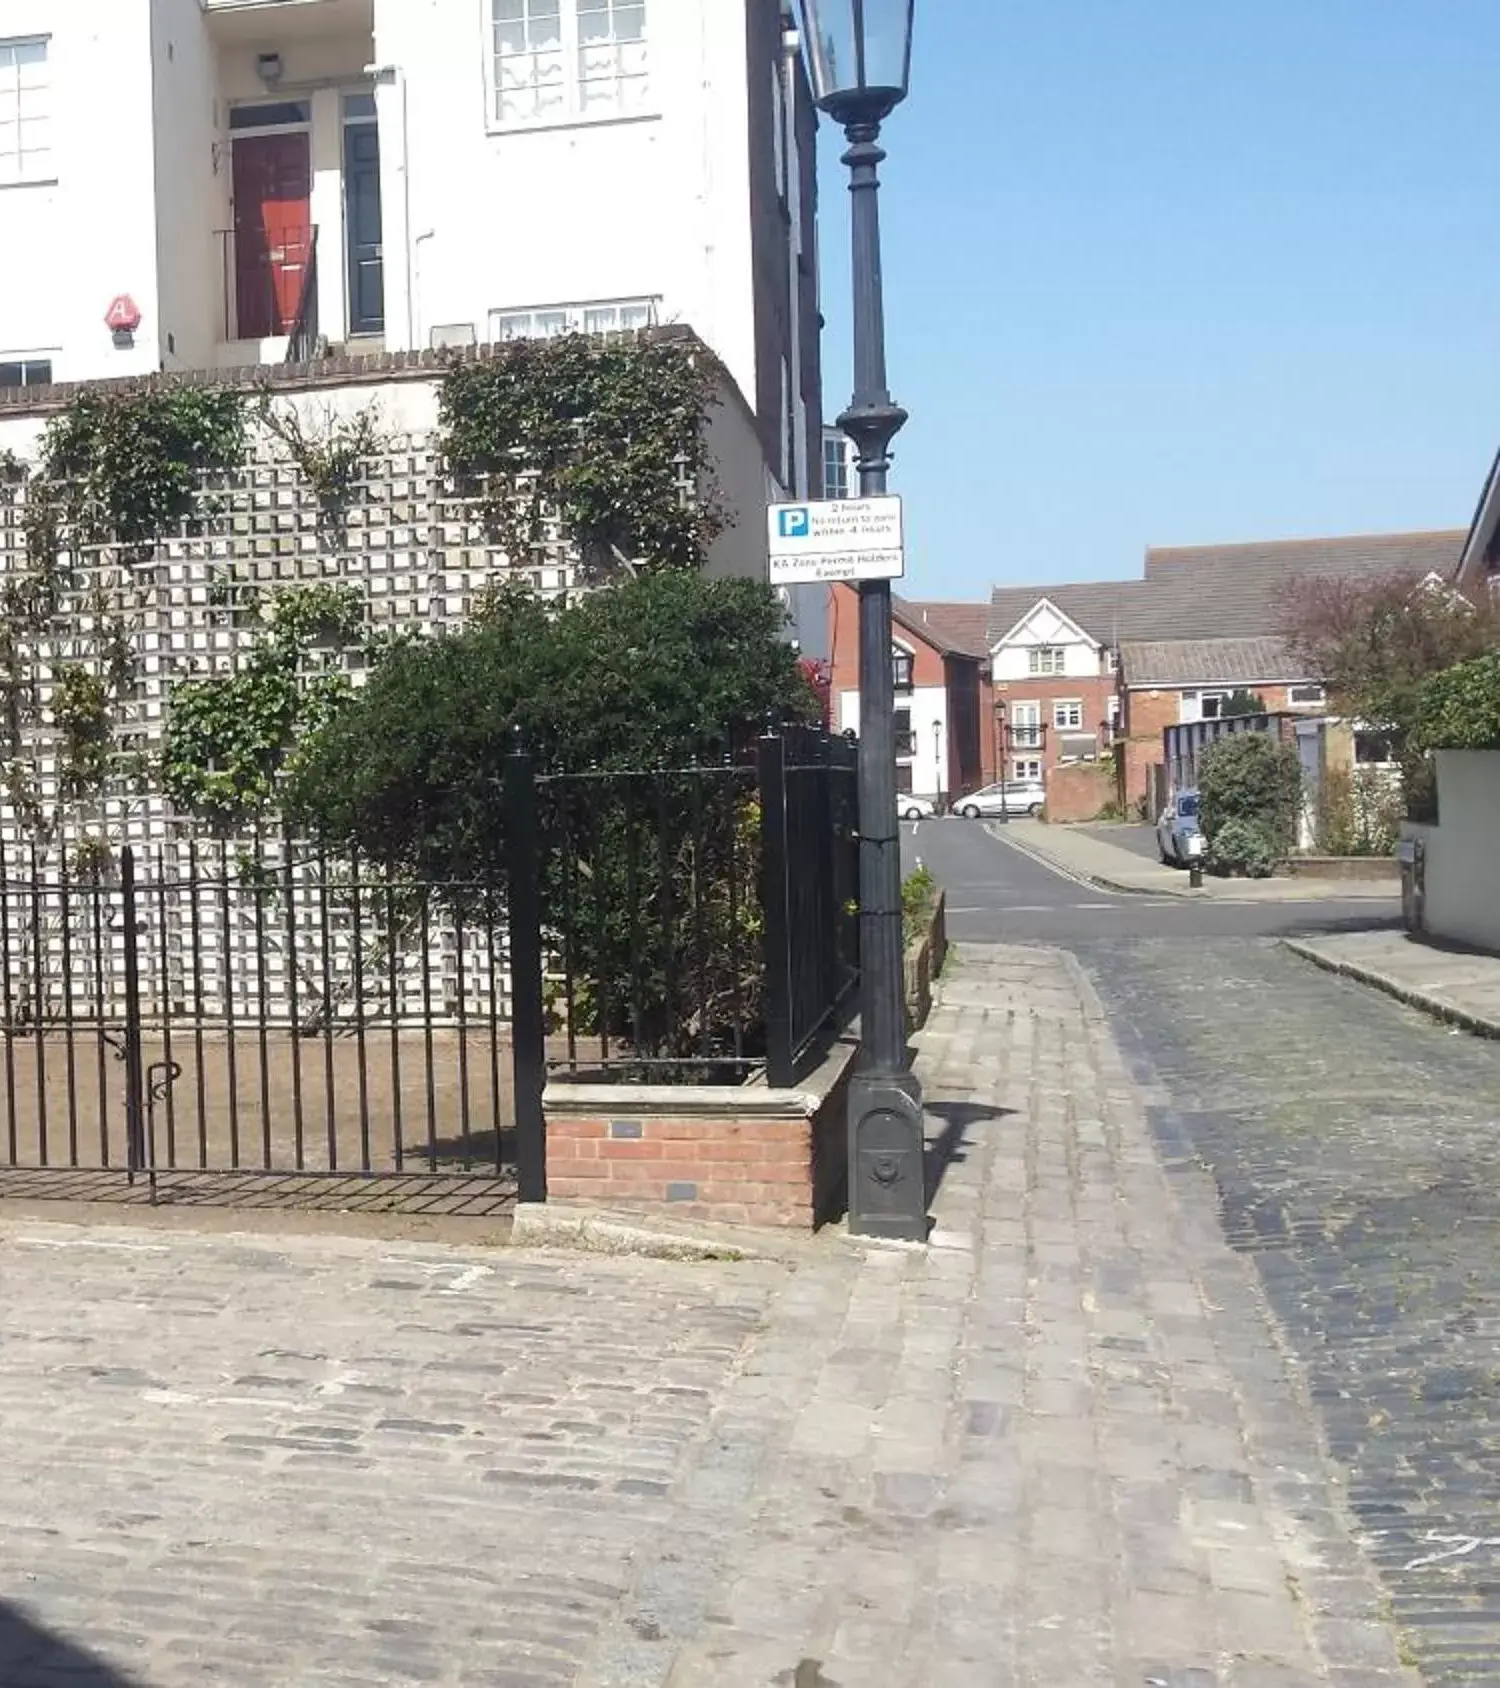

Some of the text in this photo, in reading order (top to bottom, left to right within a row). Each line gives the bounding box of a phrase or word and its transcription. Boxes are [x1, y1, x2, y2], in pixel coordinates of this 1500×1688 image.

[830, 503, 871, 513] 2 hours
[785, 511, 805, 535] P
[811, 515, 825, 525] No
[827, 514, 859, 525] return
[860, 514, 871, 523] to
[812, 524, 892, 537] within 4 hours
[791, 557, 817, 568] Zone
[820, 555, 854, 565] Permit
[857, 552, 899, 564] Holders
